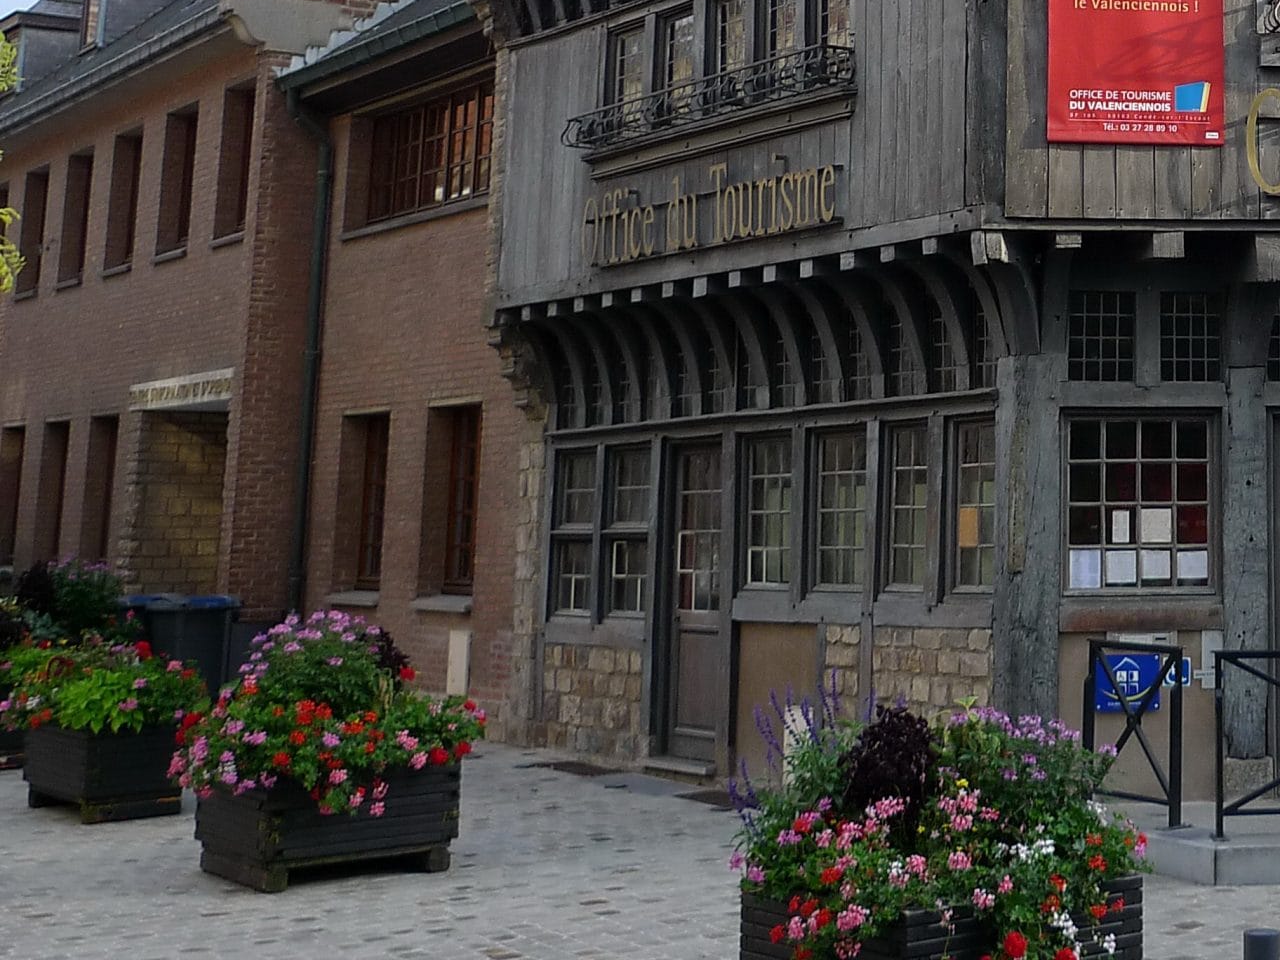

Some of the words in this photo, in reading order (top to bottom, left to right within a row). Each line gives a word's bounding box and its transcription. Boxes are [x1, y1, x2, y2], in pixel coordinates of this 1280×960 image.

[1194, 0, 1199, 13] !
[1069, 90, 1103, 99] OFFICE
[1105, 90, 1119, 100] DE
[1121, 91, 1172, 101] TOURISME
[1069, 100, 1085, 110] DU
[1088, 101, 1171, 112] VALENCIENNOIS
[1120, 123, 1130, 132] 03
[1132, 124, 1141, 132] 27
[1168, 125, 1178, 133] 10
[581, 188, 655, 265] Office
[665, 175, 698, 251] du
[709, 152, 836, 243] Tourisme
